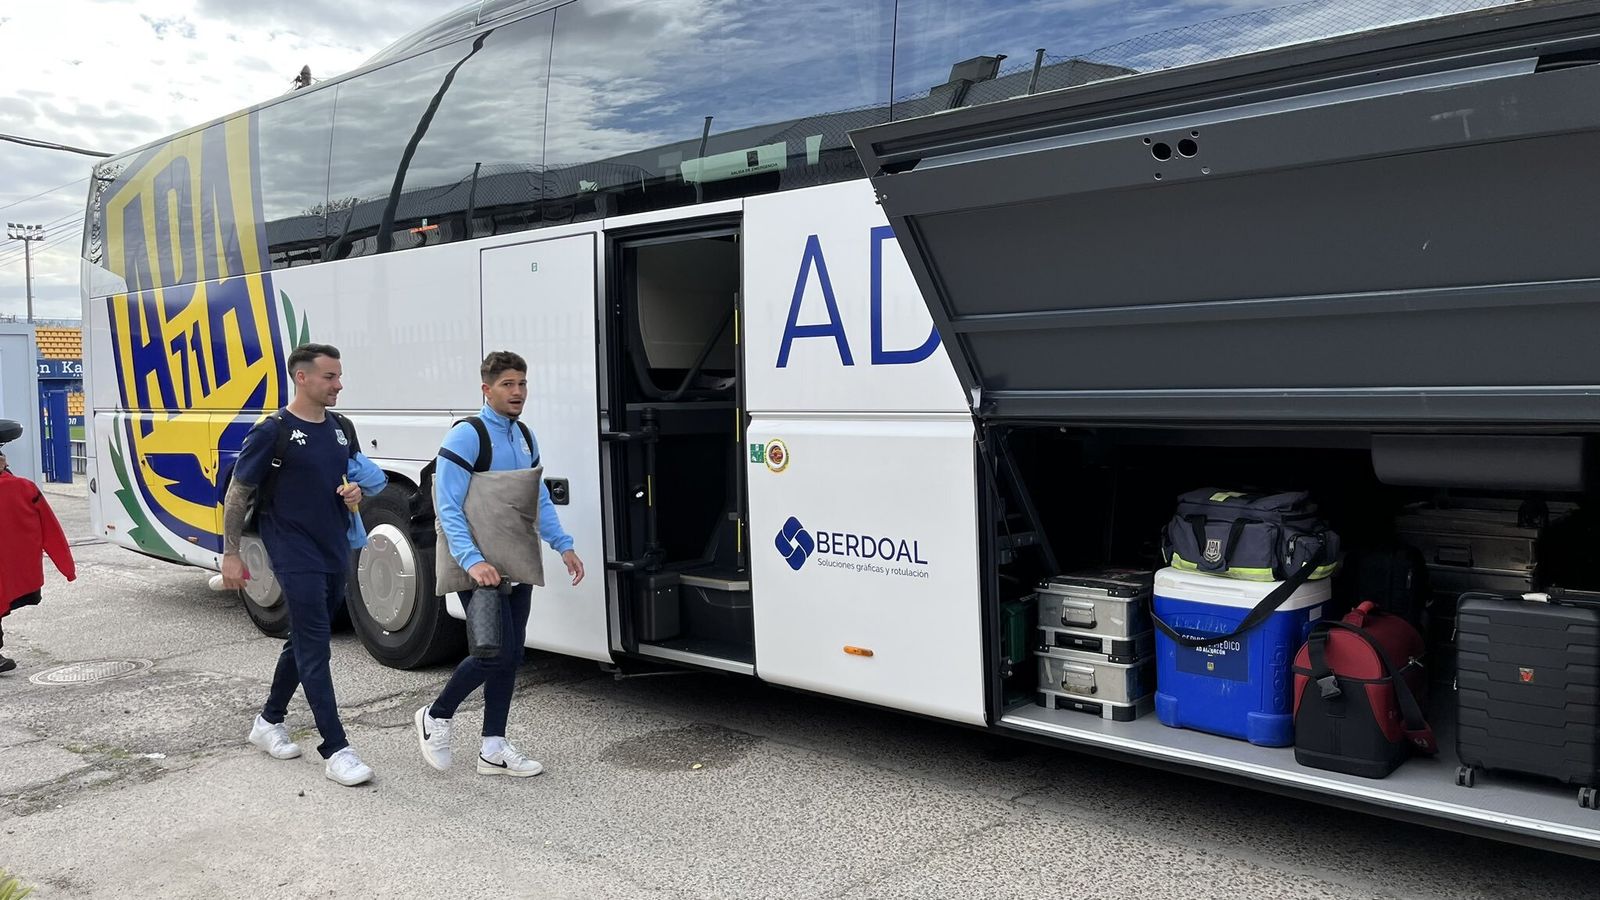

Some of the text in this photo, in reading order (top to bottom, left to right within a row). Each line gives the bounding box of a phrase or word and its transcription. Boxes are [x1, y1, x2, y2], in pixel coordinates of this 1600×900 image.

[816, 531, 928, 565] BERDOAL
[817, 558, 855, 570] Soluciones
[885, 568, 890, 576] y
[891, 567, 929, 578] rotulación
